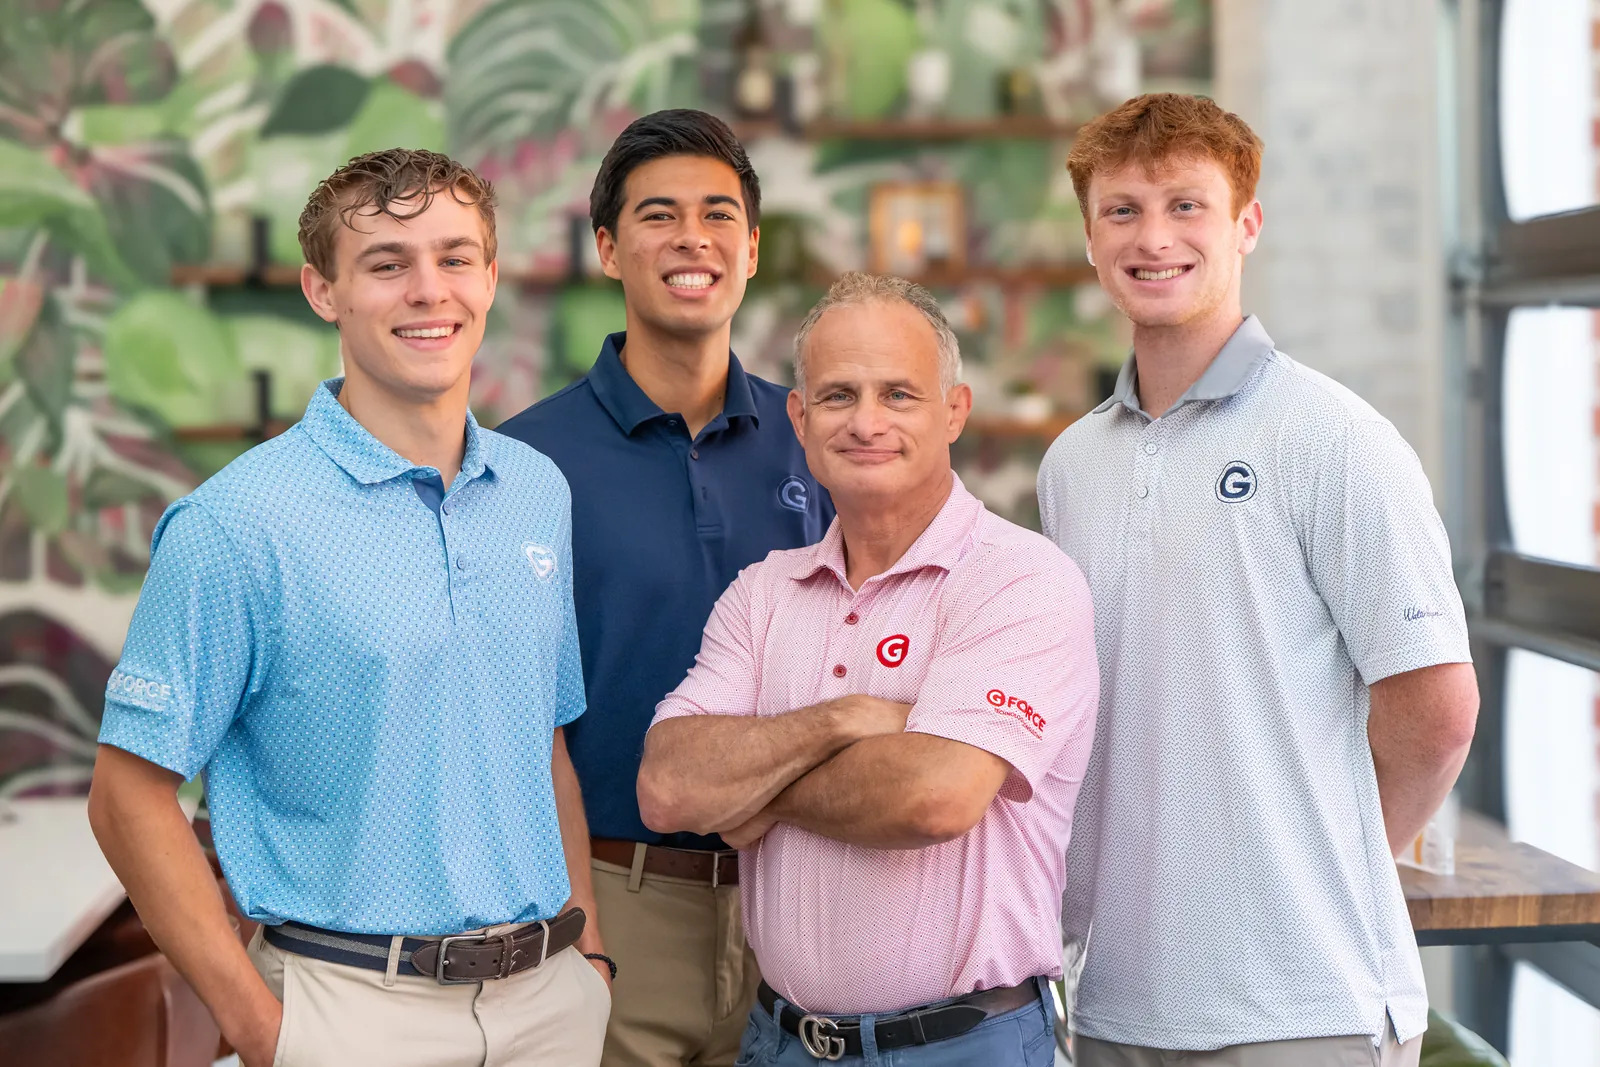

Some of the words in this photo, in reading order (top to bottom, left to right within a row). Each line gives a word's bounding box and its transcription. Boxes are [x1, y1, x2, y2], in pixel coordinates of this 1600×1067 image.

[780, 479, 808, 511] G
[1218, 464, 1252, 500] G
[524, 543, 554, 579] G
[880, 636, 907, 665] G
[988, 690, 1004, 705] G
[1008, 696, 1046, 732] FORCE
